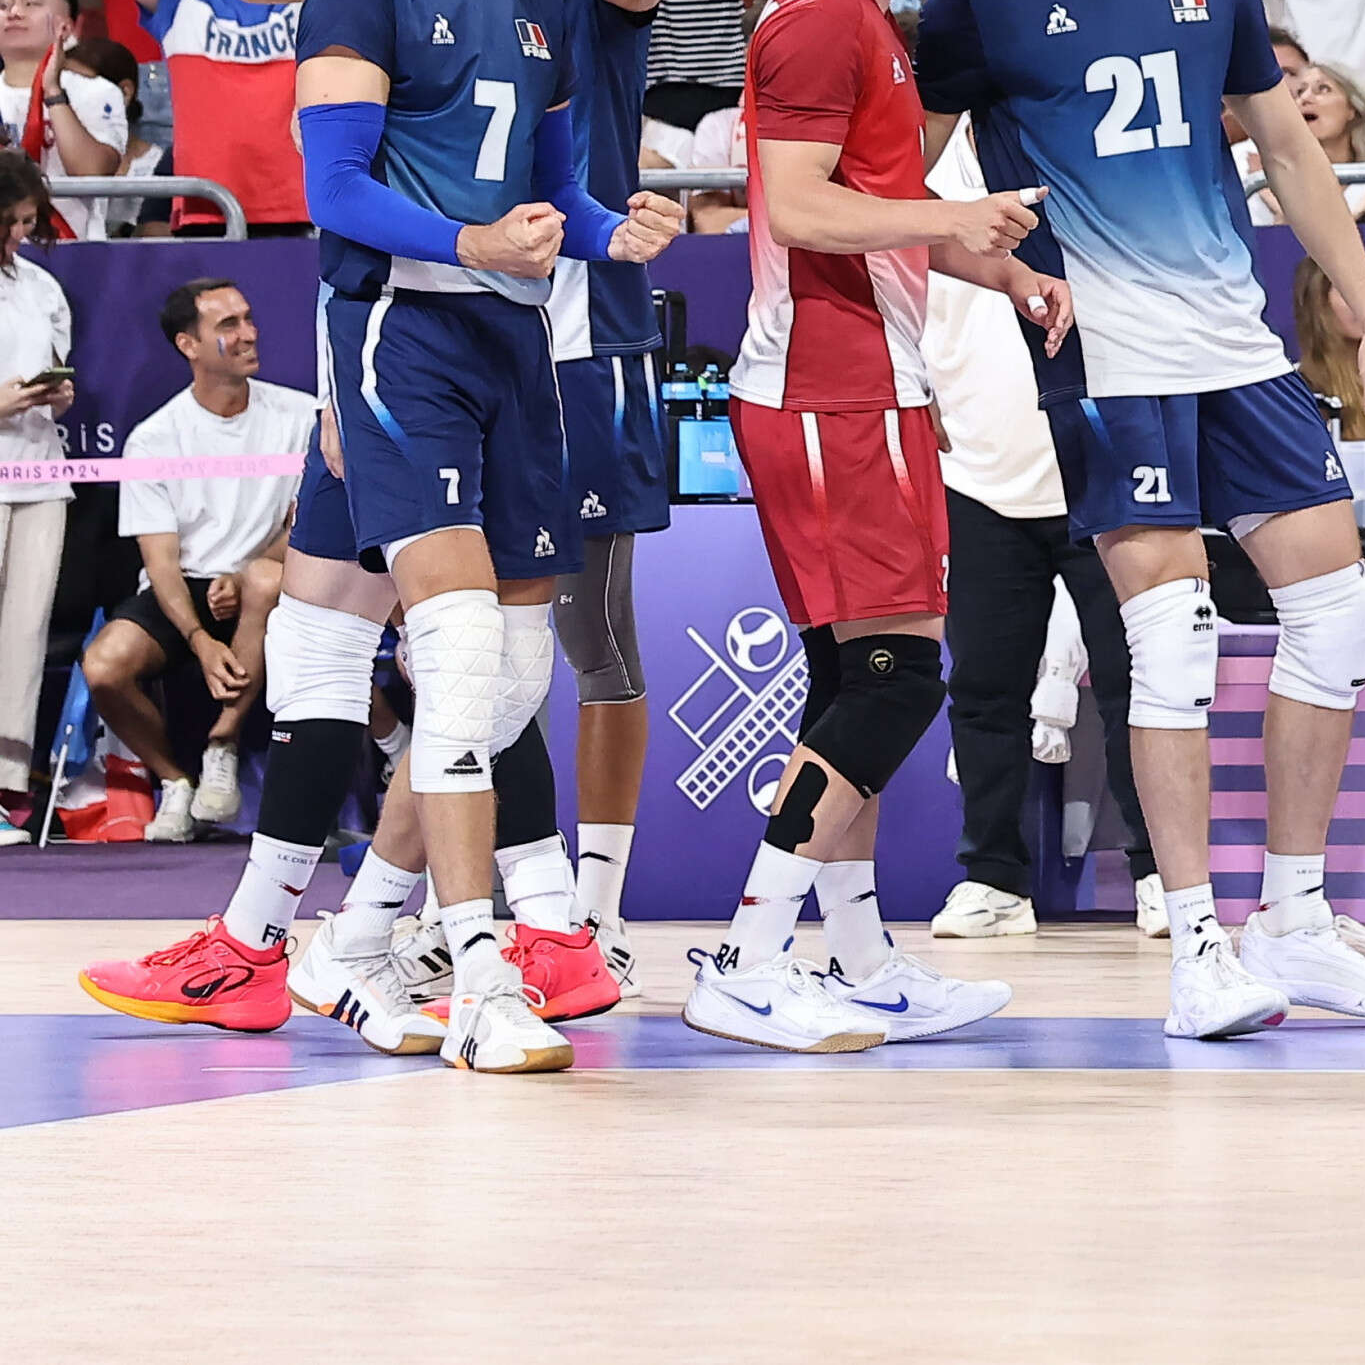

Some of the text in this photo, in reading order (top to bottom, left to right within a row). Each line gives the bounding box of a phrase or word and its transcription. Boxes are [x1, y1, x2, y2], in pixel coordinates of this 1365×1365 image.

[1173, 8, 1210, 24] FRA
[204, 12, 297, 59] FRANCE
[521, 44, 552, 60] FRA
[1084, 50, 1191, 158] 21
[474, 82, 517, 182] 7
[438, 468, 461, 505] 7
[1132, 466, 1172, 502] 21
